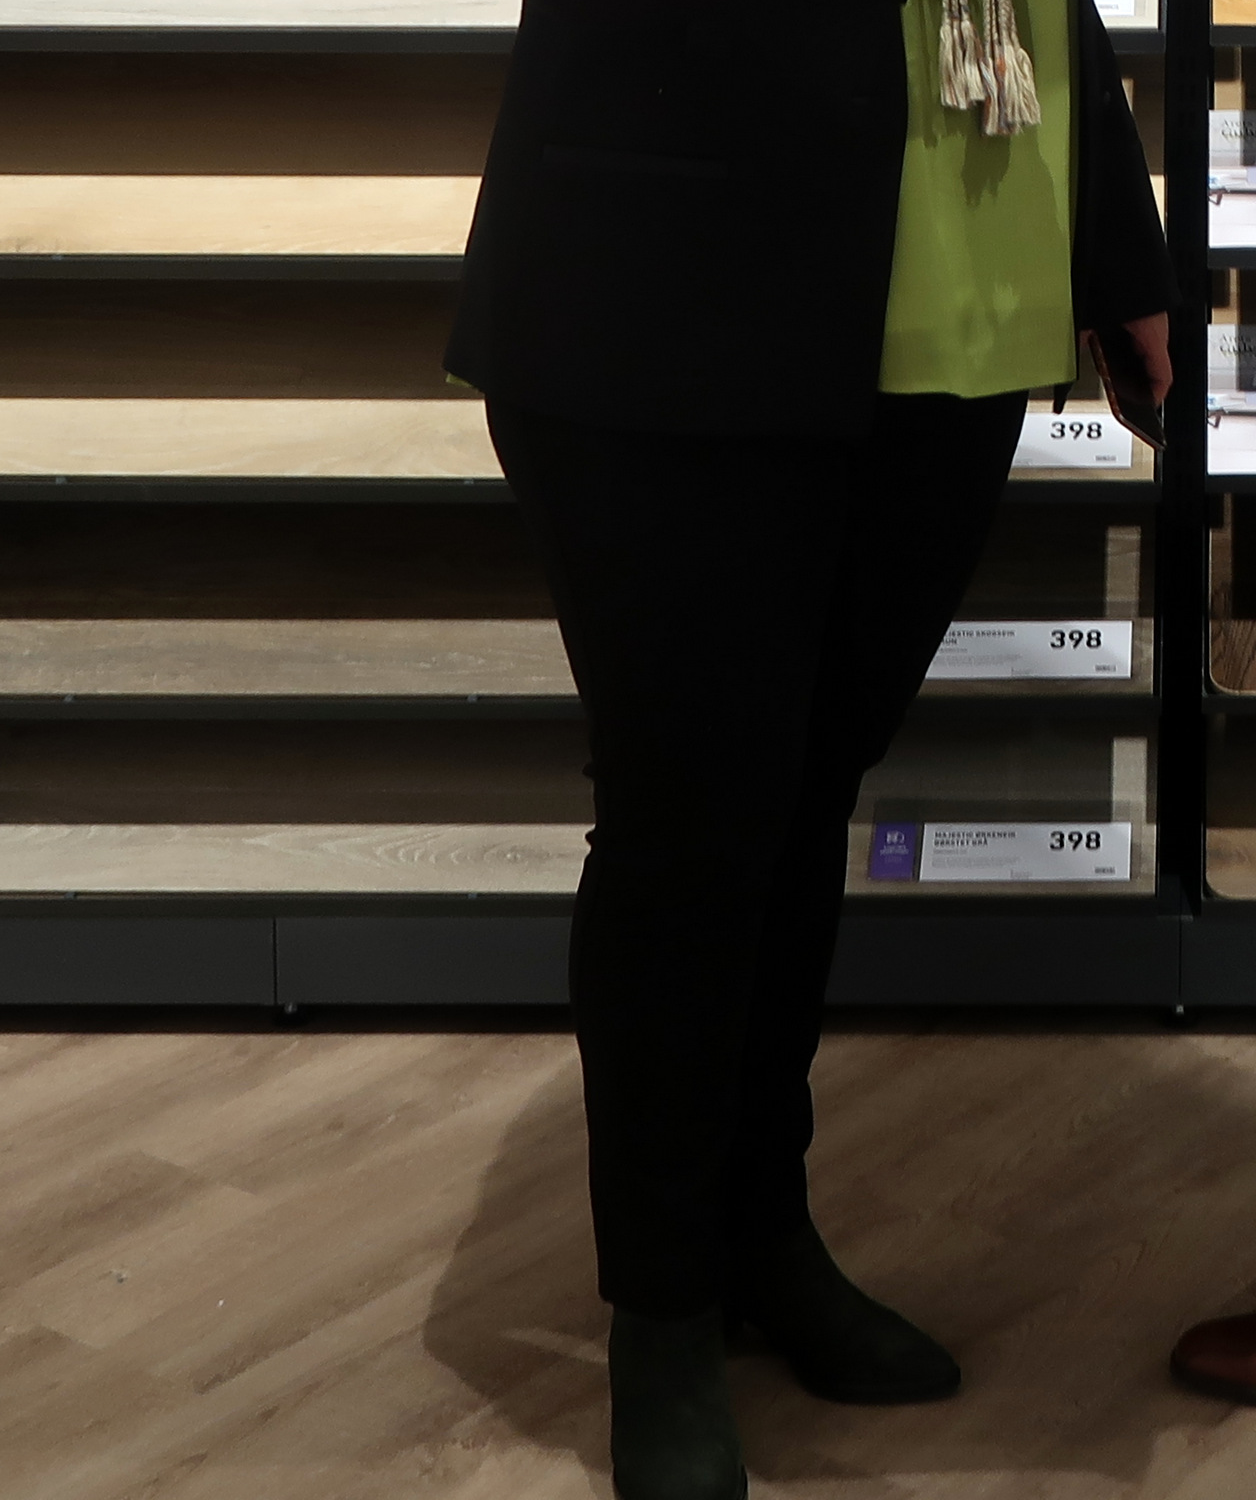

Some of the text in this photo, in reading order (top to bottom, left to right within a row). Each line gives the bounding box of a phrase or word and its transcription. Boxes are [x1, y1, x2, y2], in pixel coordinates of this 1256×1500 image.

[1050, 421, 1102, 440] 398
[1050, 630, 1102, 649] 398
[1050, 831, 1102, 851] 398
